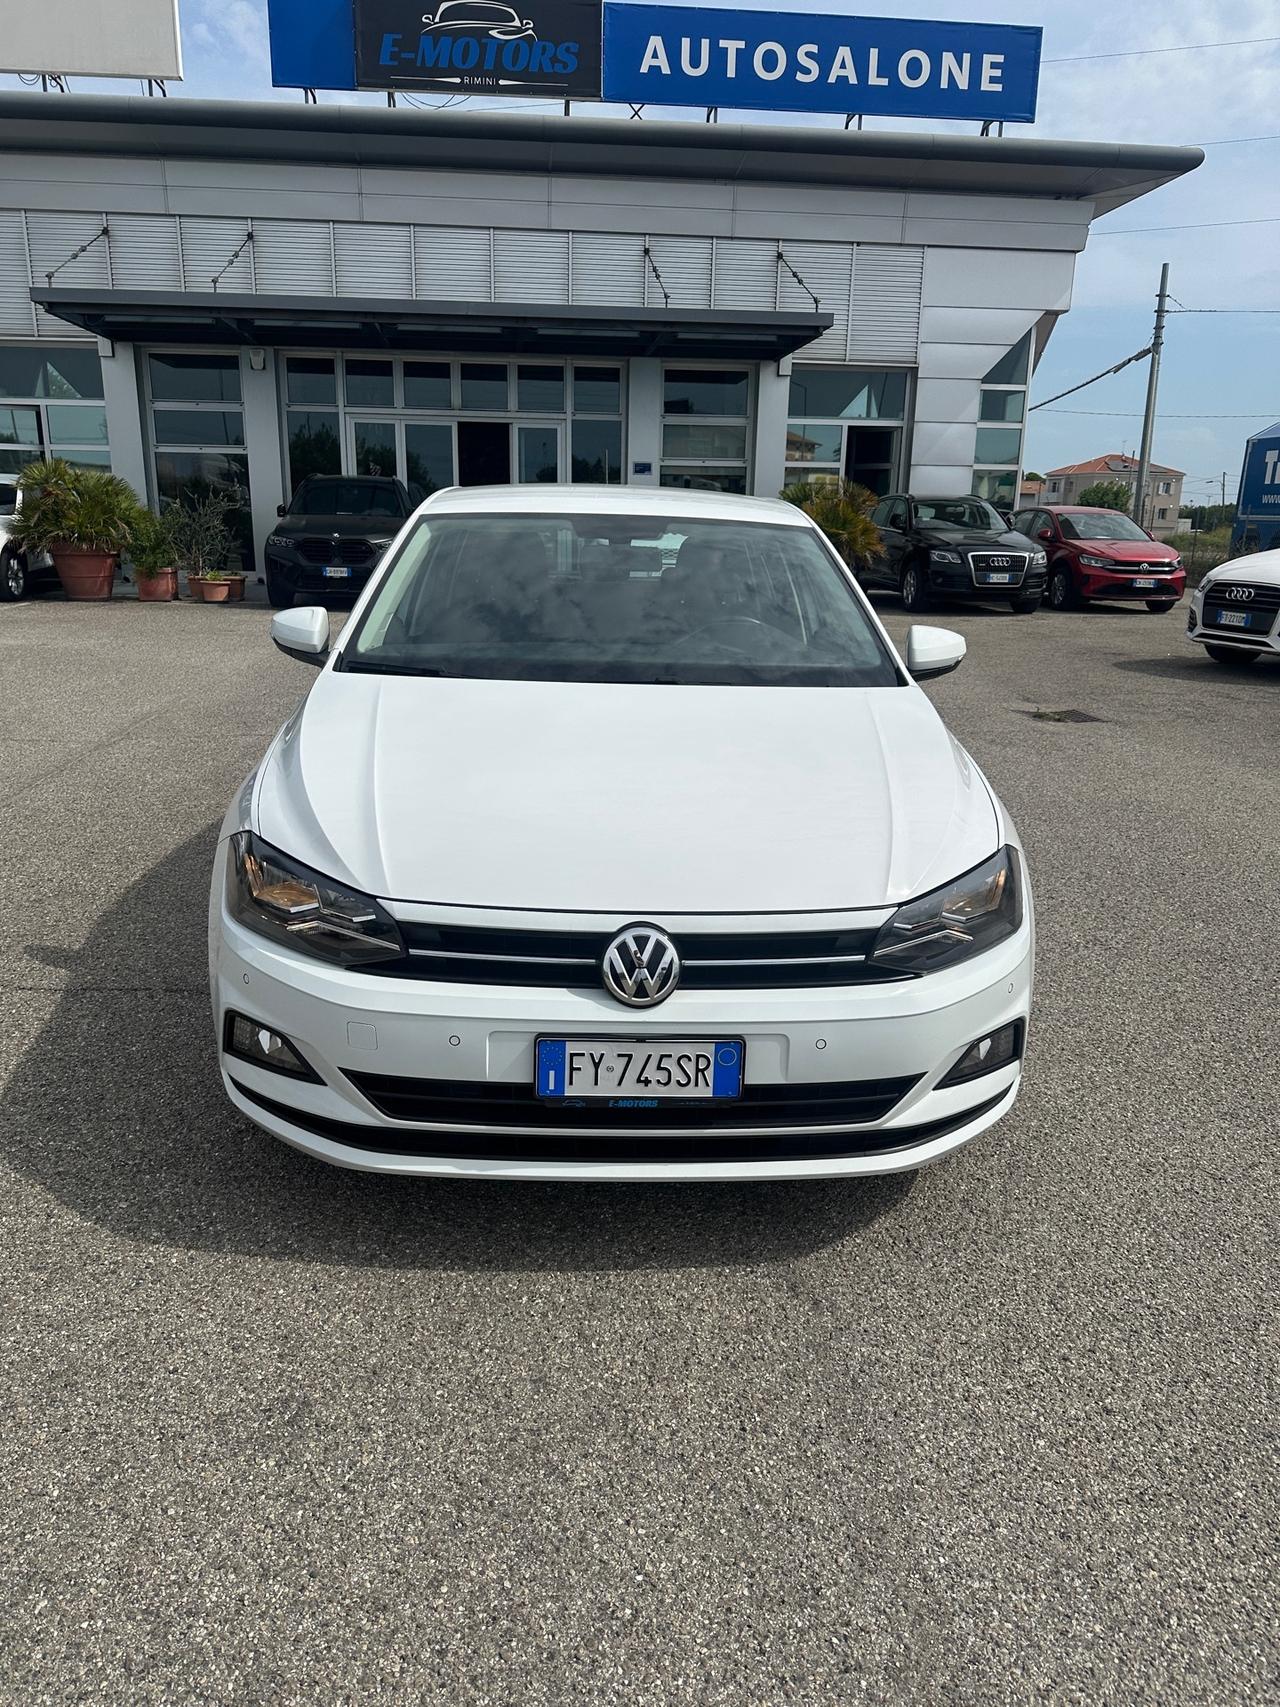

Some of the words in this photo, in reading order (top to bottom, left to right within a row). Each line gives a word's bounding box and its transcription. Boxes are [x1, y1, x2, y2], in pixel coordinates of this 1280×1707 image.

[378, 33, 579, 74] E-MOTORS
[639, 35, 1005, 92] AUTOSALONE
[464, 76, 497, 86] RIMINI
[608, 1099, 659, 1108] E-MOTORS
